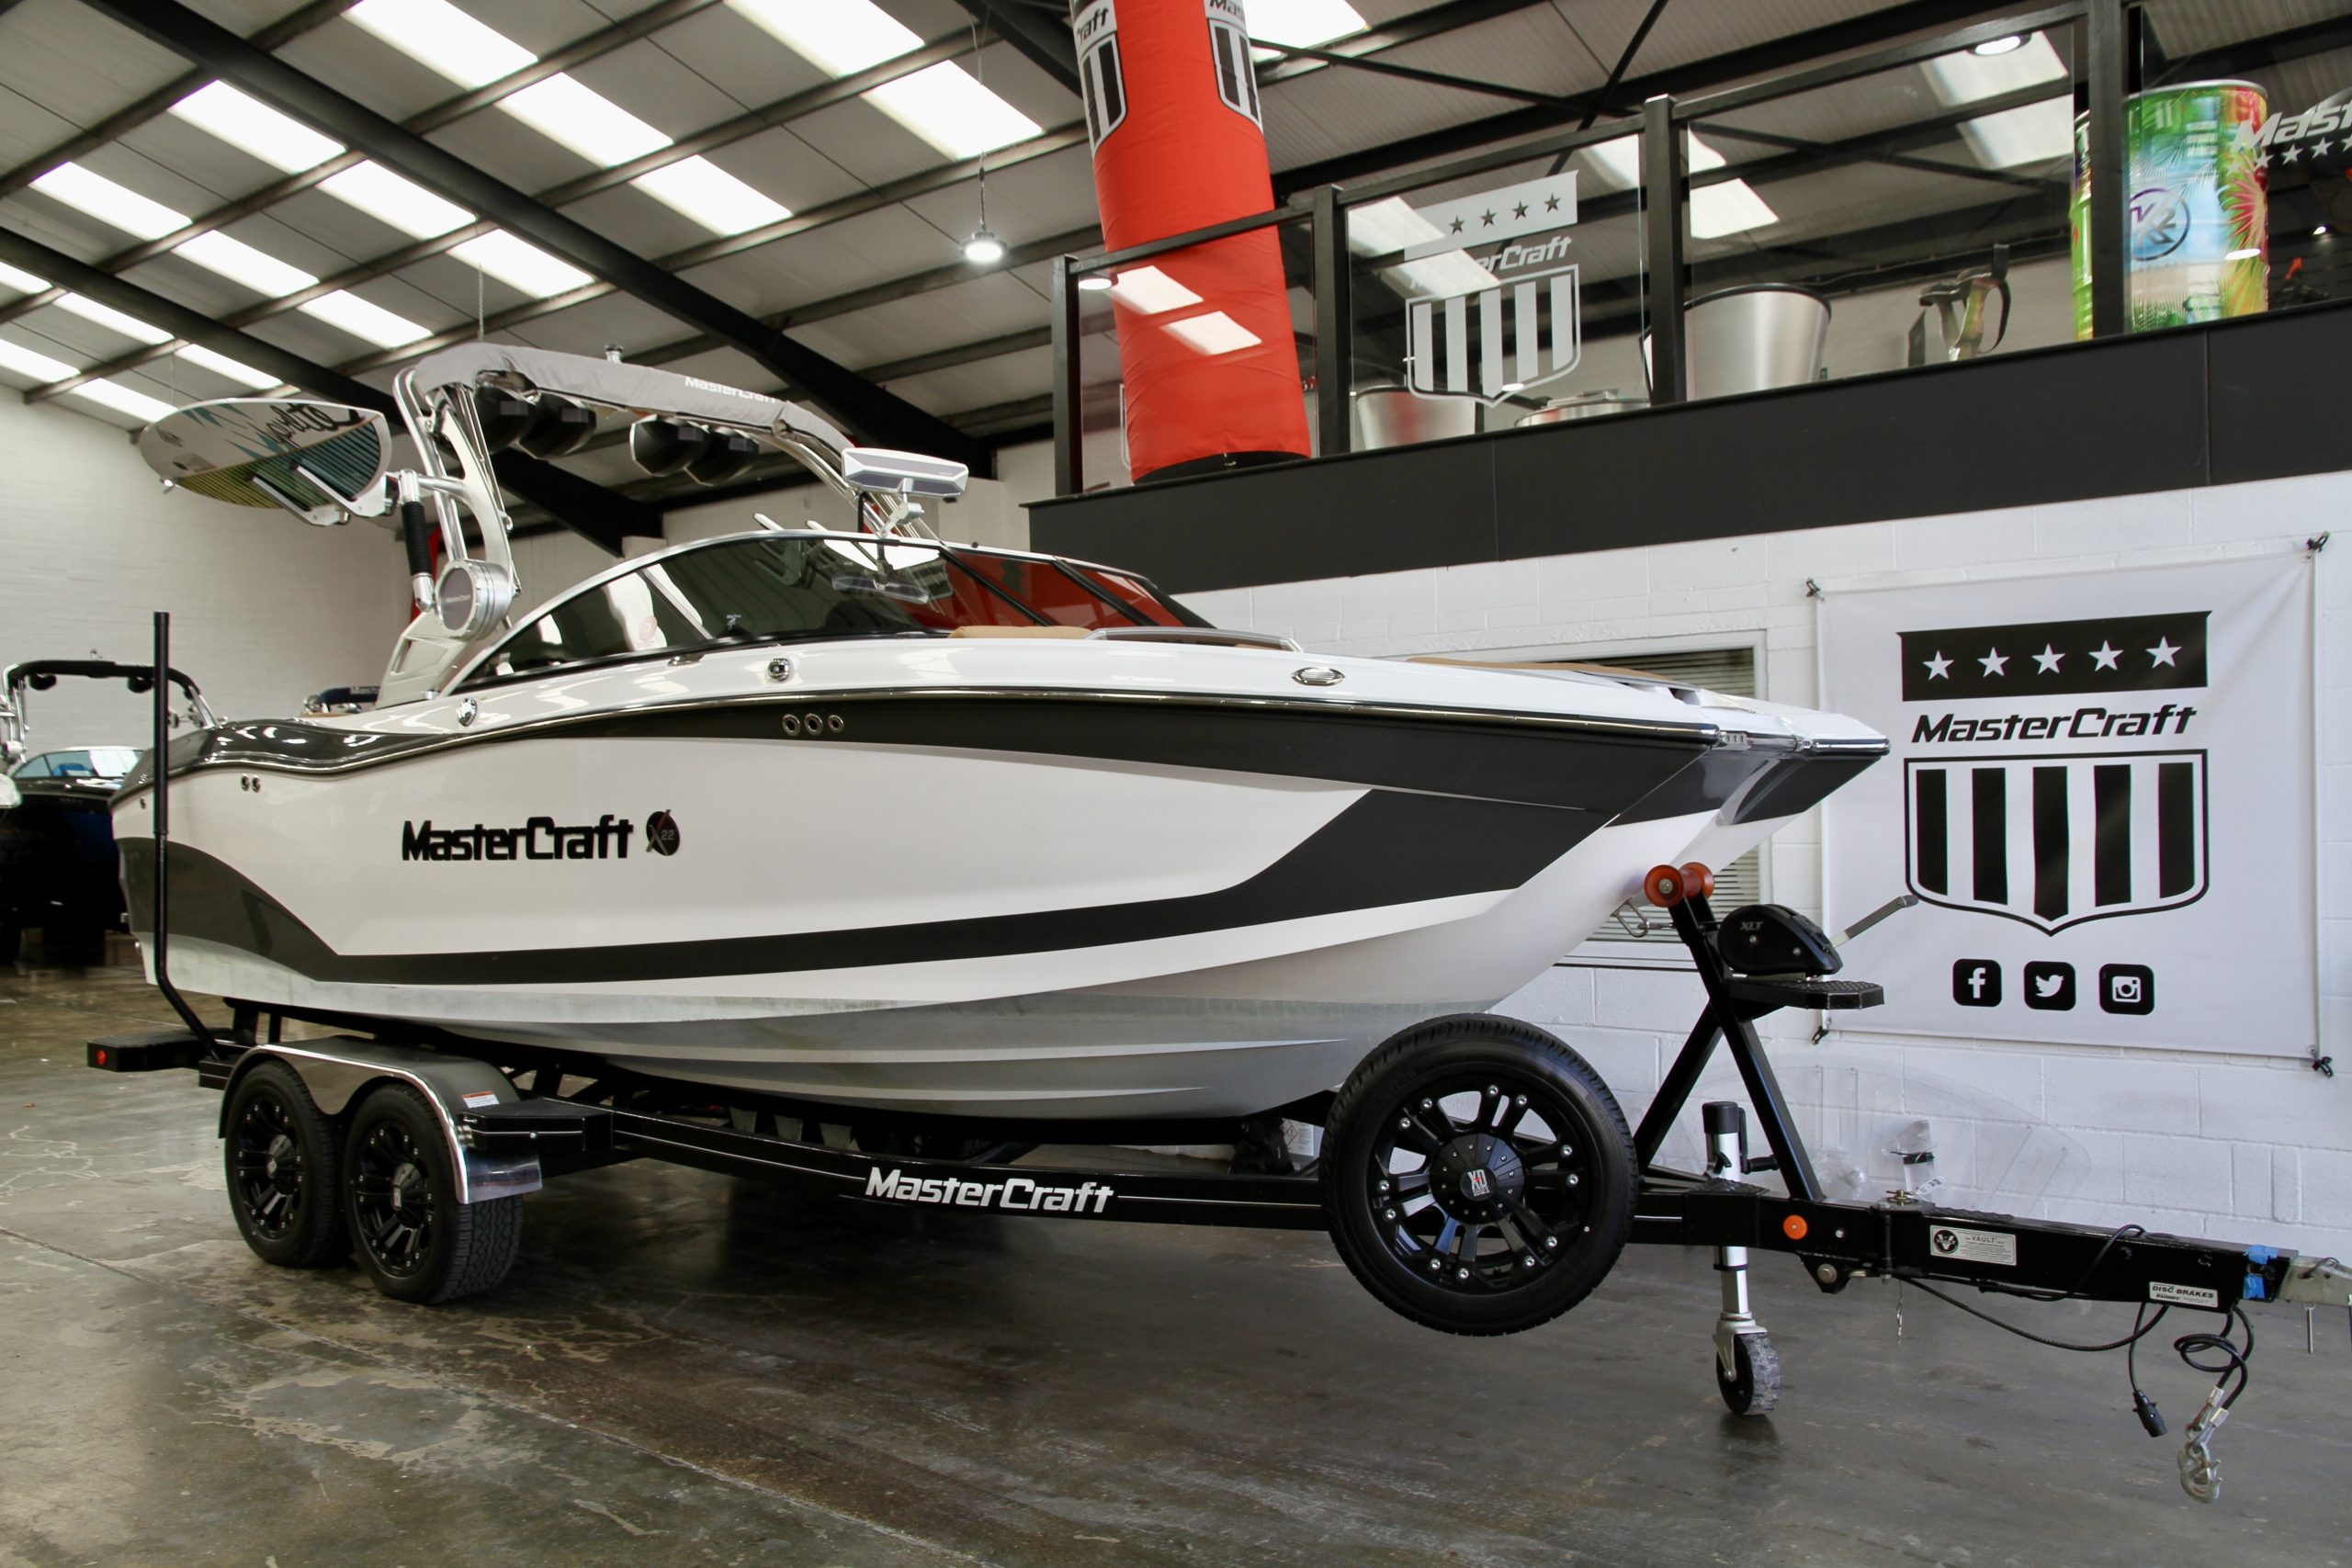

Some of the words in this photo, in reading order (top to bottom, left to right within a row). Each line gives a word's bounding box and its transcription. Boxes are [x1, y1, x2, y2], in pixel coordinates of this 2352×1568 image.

[1911, 704, 2198, 743] MasterCraft
[401, 814, 634, 861] MasterCraft
[1740, 921, 1764, 931] XLT
[865, 1166, 1114, 1213] MasterCraft
[1971, 1235, 1996, 1244] VAULT
[2152, 1285, 2175, 1293] DISC
[2176, 1289, 2214, 1299] BRAKES
